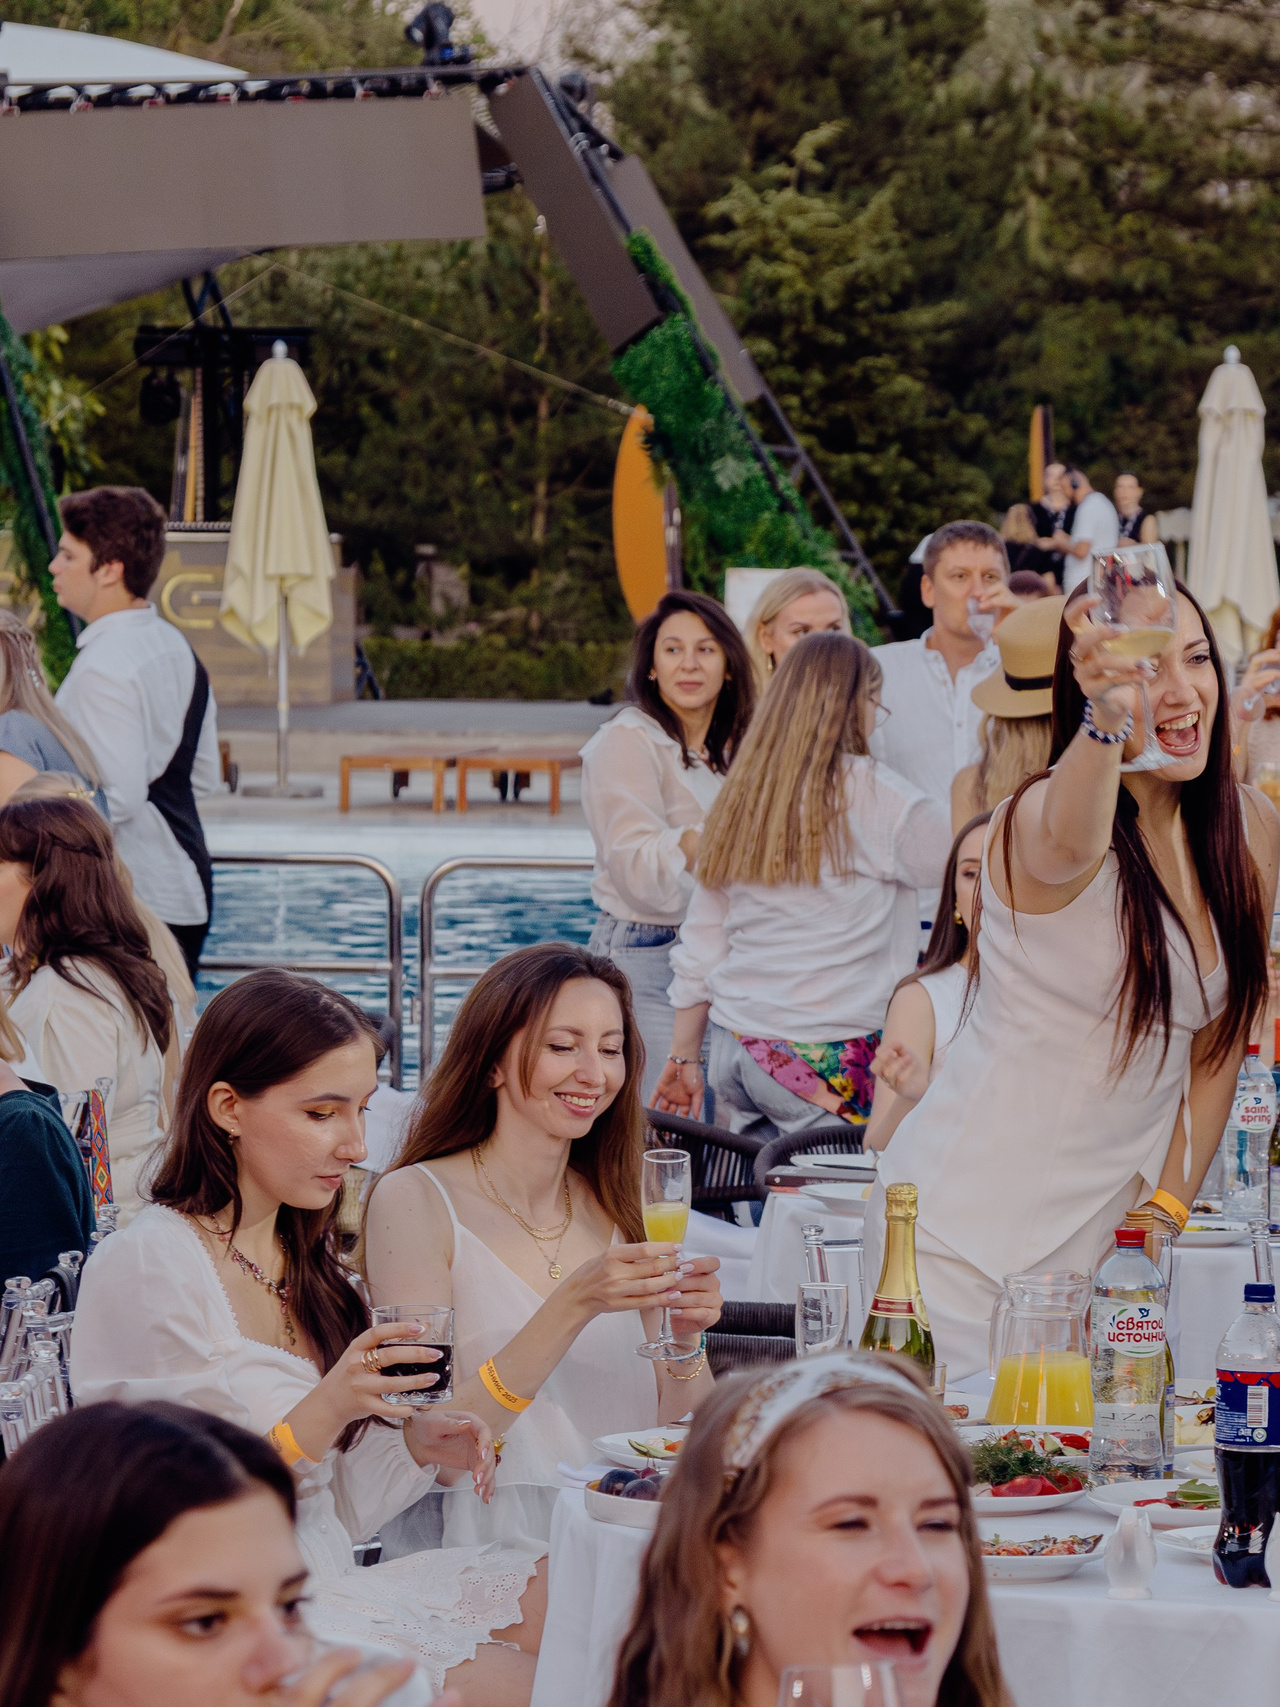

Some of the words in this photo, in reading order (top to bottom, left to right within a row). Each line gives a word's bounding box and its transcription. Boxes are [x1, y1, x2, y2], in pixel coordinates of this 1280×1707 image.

[1244, 1105, 1270, 1114] saint
[1240, 1114, 1272, 1125] spring
[502, 1391, 518, 1404] 2025
